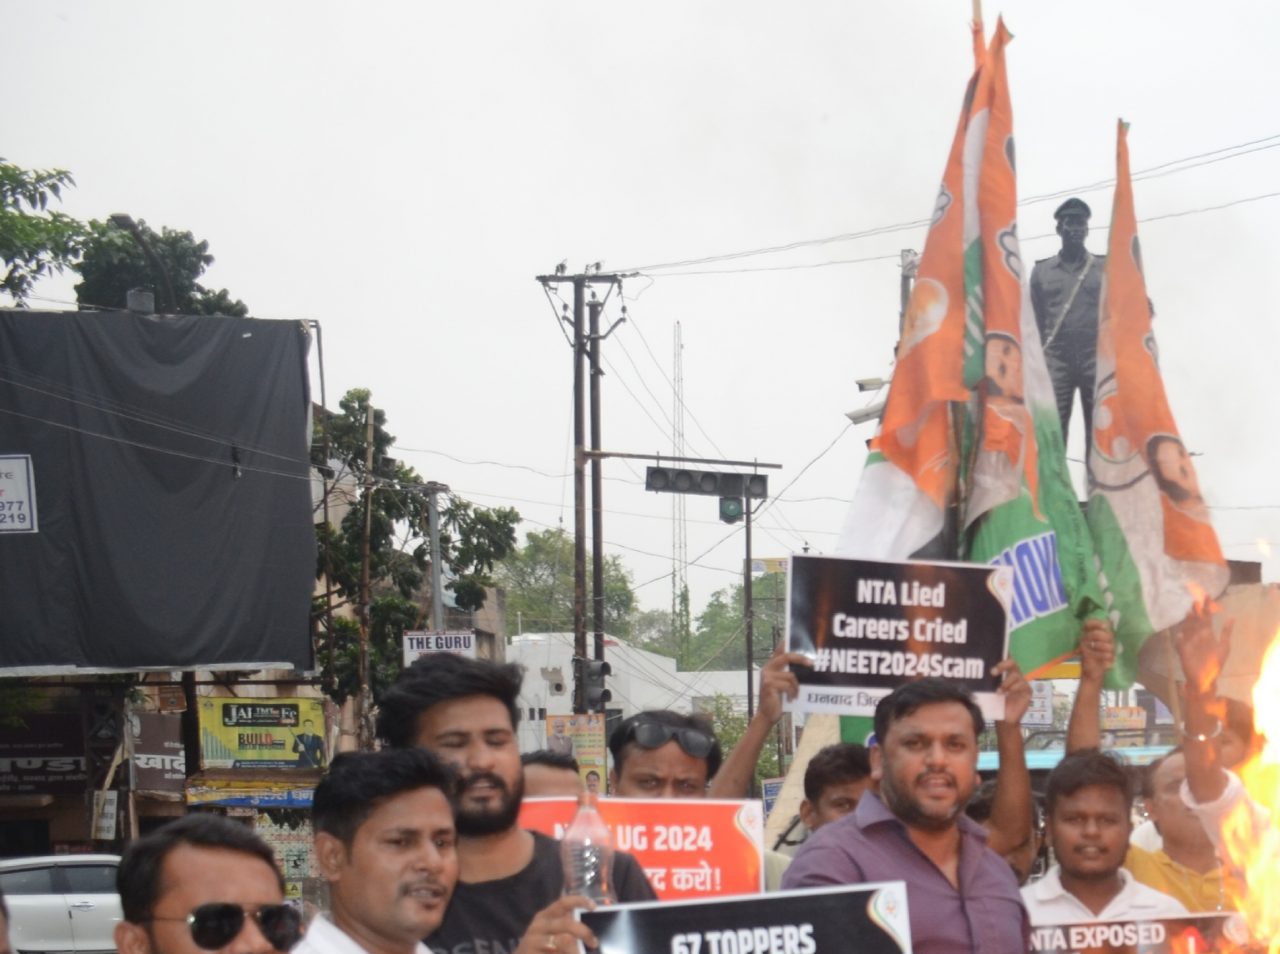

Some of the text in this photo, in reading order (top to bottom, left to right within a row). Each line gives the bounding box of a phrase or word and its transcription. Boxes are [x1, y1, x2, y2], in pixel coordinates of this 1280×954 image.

[857, 578, 945, 607] NTA Lied
[408, 636, 471, 649] THE GURU
[832, 613, 967, 644] Careers Cried
[812, 648, 985, 680] #NEET2024Scam
[224, 704, 252, 725] JAI
[617, 825, 713, 850] UG 2024
[1029, 922, 1166, 951] NTA EXPOSED
